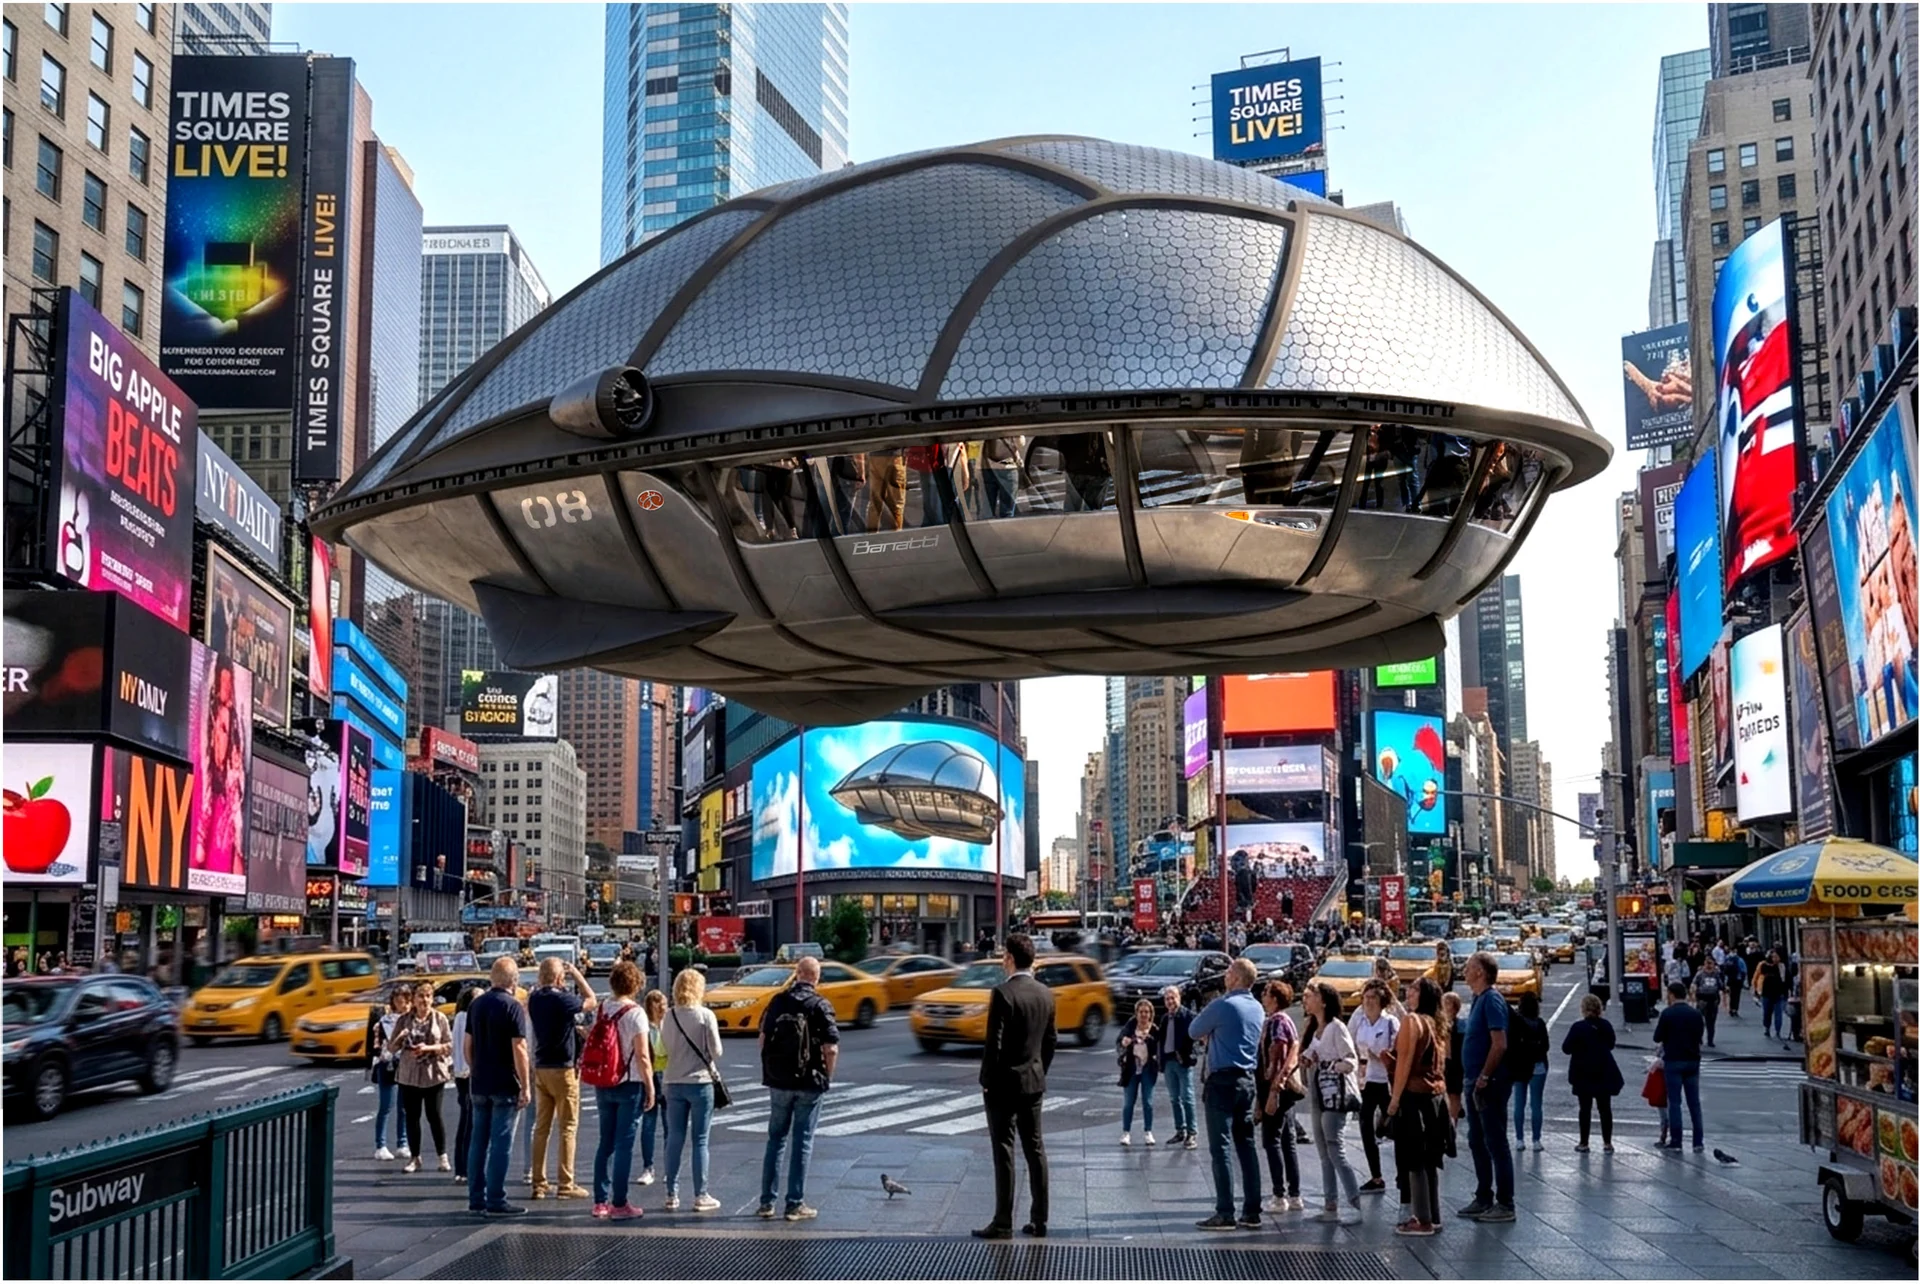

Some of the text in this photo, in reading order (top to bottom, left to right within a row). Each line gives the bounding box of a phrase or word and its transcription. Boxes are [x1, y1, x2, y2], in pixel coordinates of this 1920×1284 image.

[176, 91, 291, 119] TIMES
[1229, 78, 1303, 106] TIMES
[1229, 97, 1304, 121] SQUARE
[175, 121, 290, 142] SQUARE
[1231, 113, 1303, 145] LIVE!
[174, 145, 288, 178] LIVE!
[307, 194, 337, 451] TIMES SQUARE LIVE!
[90, 331, 123, 392] BIG
[126, 369, 182, 444] APPLE
[106, 397, 178, 518] BEATS
[204, 452, 229, 512] NY
[236, 483, 276, 554] DAILY
[521, 490, 593, 529] 08
[126, 755, 195, 889] NY
[1823, 885, 1872, 898] FOOD
[49, 1173, 145, 1223] Subway
